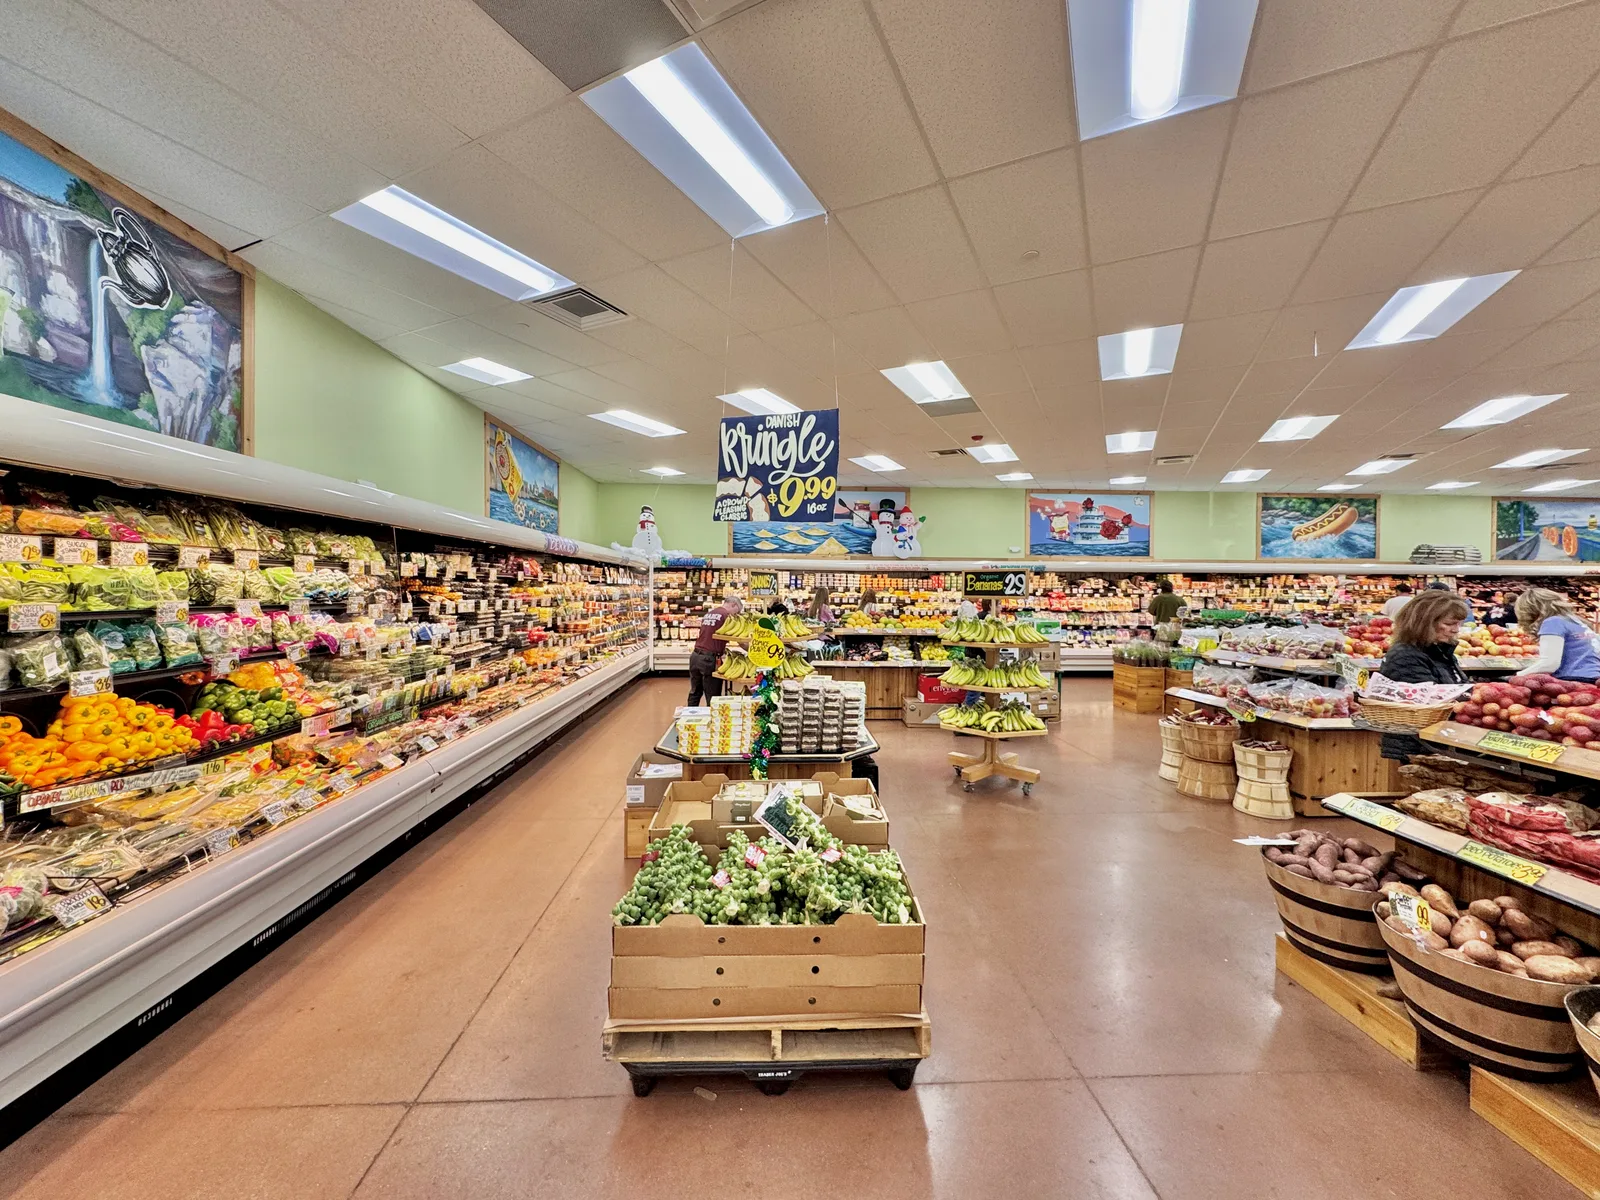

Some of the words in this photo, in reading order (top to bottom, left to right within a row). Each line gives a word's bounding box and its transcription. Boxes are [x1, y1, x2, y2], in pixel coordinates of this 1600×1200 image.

[765, 413, 801, 429] DANISH
[720, 414, 835, 485] Kringle
[715, 505, 747, 517] PLEASING
[719, 511, 748, 521] CLASSIC
[966, 574, 1004, 591] Bananas
